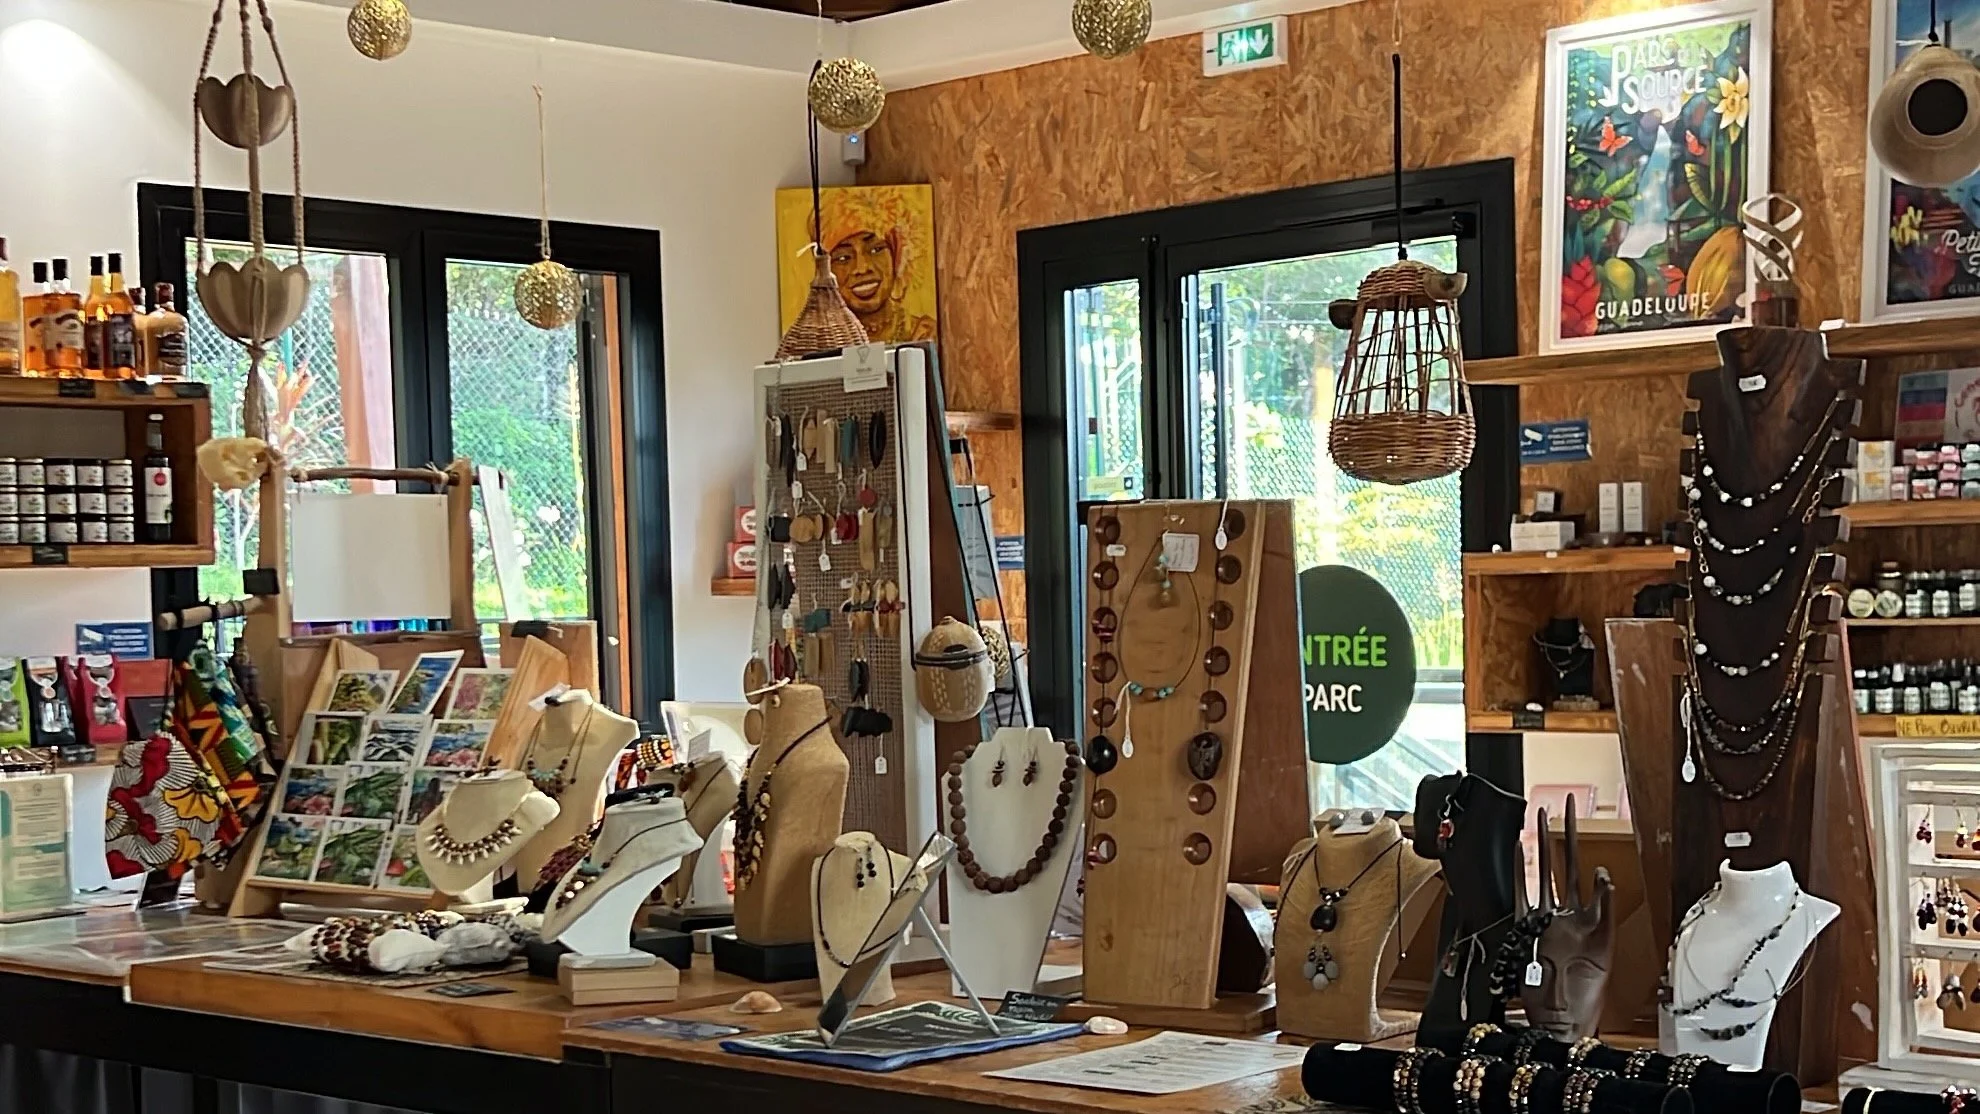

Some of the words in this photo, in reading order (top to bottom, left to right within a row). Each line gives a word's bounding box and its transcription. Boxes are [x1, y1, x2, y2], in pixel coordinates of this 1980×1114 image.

[1622, 65, 1707, 114] SOURCE
[1595, 292, 1710, 319] GUADELOUPE
[1304, 683, 1363, 712] PARC
